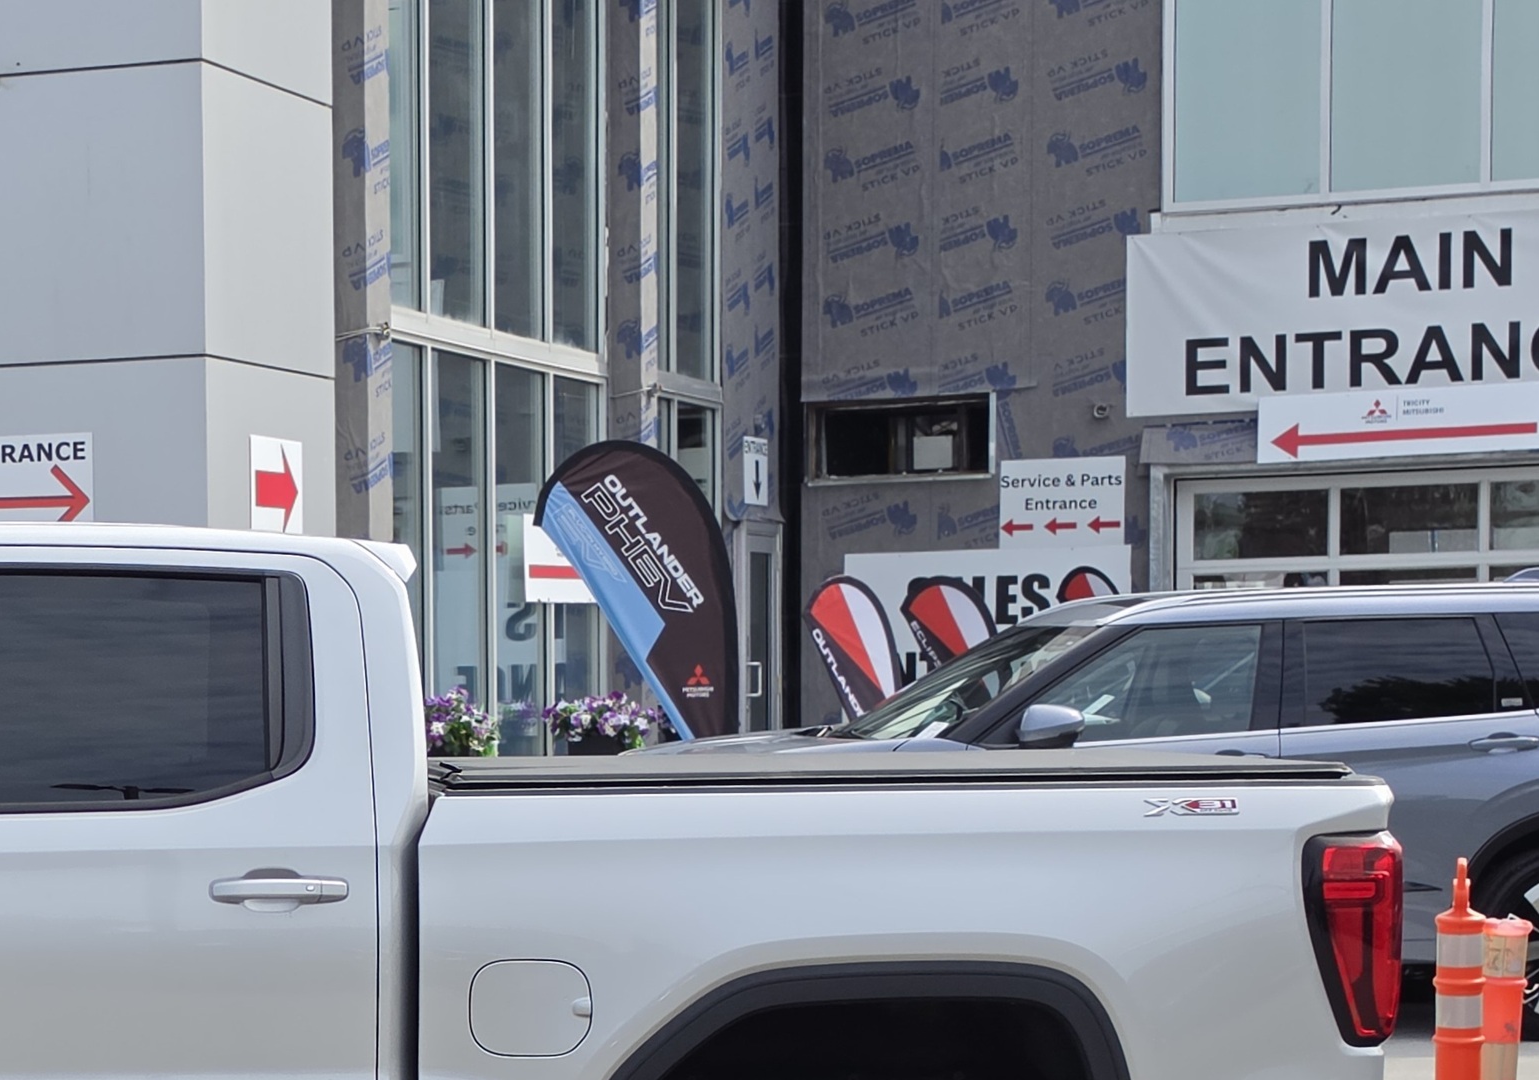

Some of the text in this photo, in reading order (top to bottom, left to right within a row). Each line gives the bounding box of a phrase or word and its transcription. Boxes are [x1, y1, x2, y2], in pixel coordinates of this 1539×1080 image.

[1309, 227, 1513, 298] MAIN
[1185, 321, 1539, 396] ENTRAN
[1000, 473, 1122, 489] Service & Parts
[1025, 498, 1097, 511] Entrance
[581, 482, 694, 613] PHEV
[603, 474, 705, 608] OUTLANDER
[812, 628, 864, 717] OUTLAND
